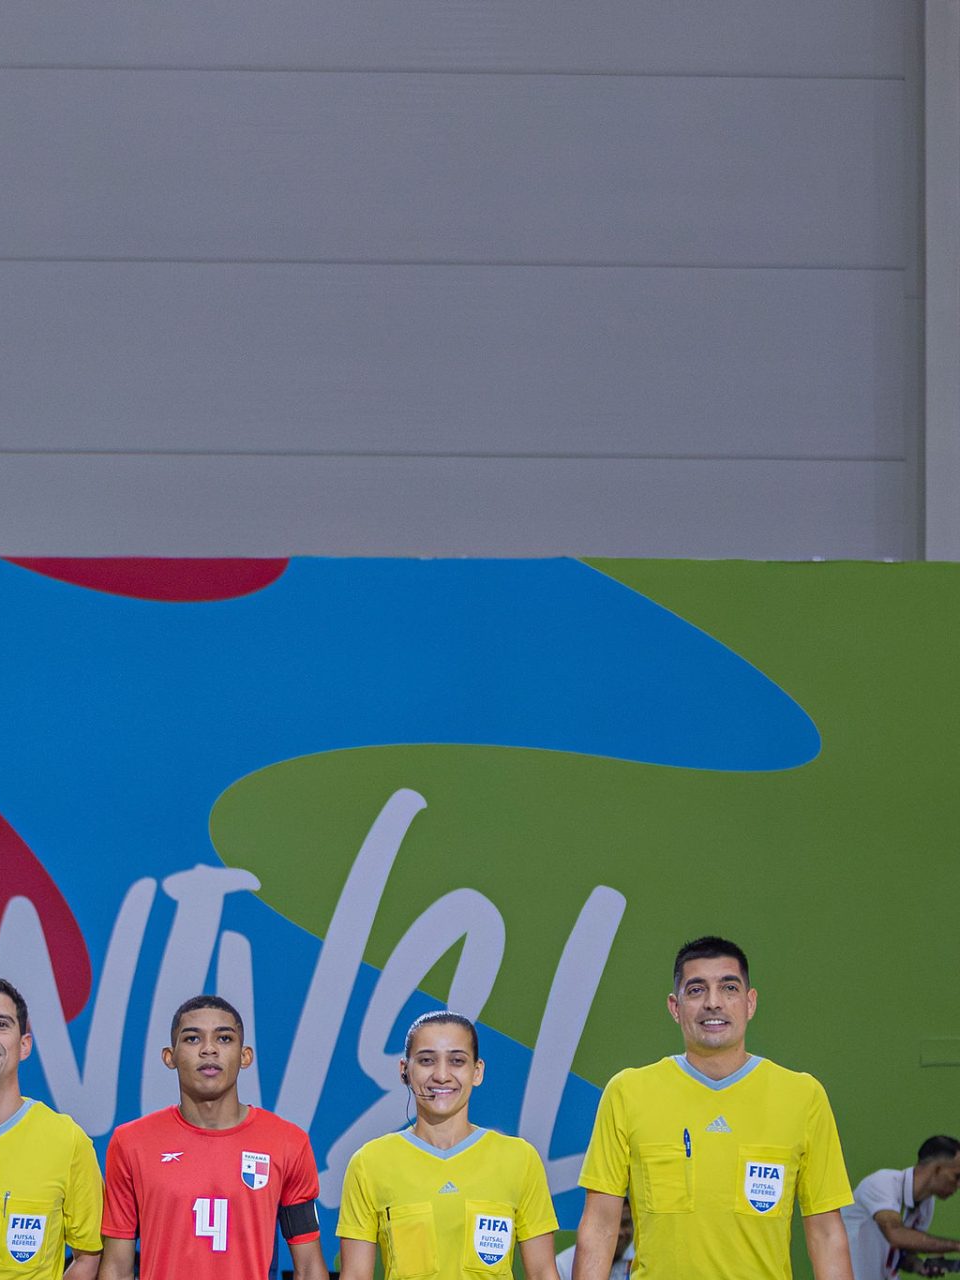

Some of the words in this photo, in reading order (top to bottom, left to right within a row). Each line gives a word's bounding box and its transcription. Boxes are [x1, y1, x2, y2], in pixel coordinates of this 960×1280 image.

[749, 1165, 780, 1180] FIFA
[11, 1217, 41, 1230] FIFA
[192, 1198, 228, 1251] 4
[479, 1218, 508, 1232] FIFA
[479, 1241, 504, 1249] REFEREE
[481, 1235, 503, 1243] FUTSAL
